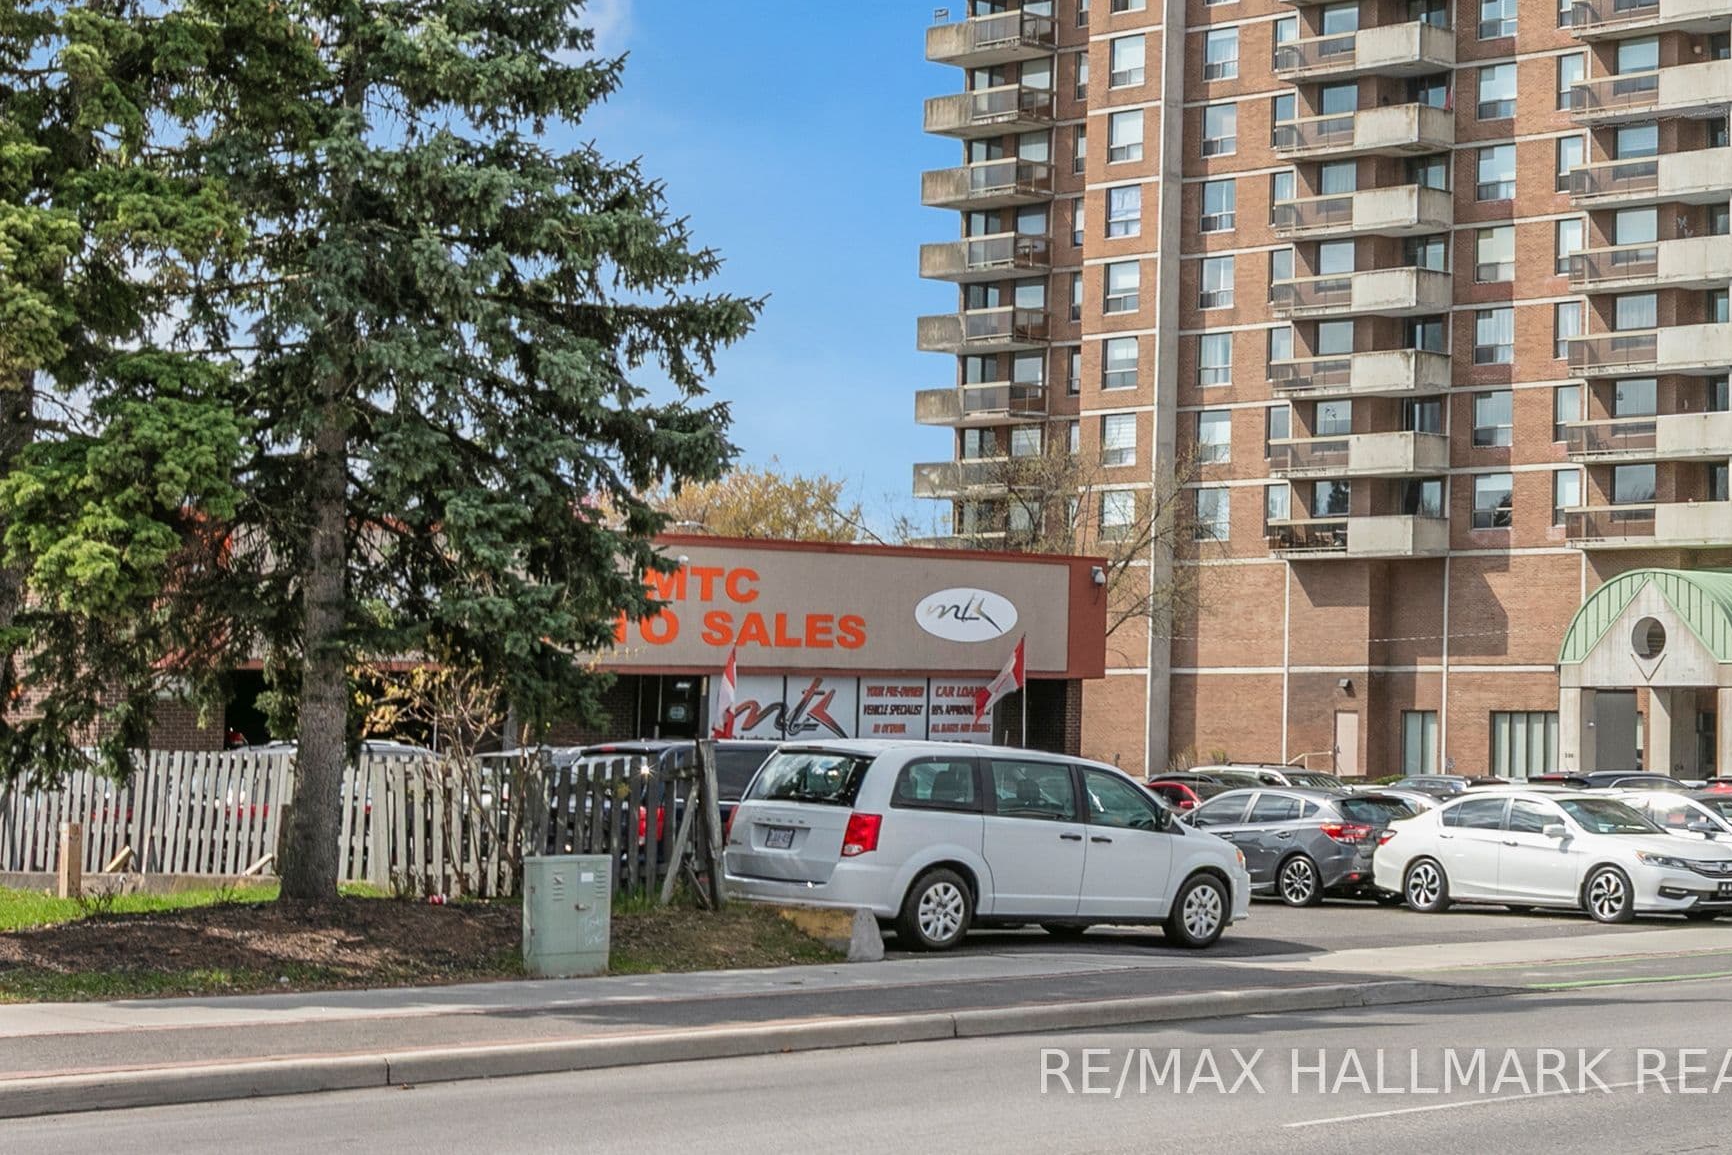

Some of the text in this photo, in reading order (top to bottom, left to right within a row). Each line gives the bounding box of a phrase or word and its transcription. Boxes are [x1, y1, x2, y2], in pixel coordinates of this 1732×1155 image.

[701, 609, 867, 649] SALES
[935, 685, 955, 698] CAR
[889, 704, 924, 716] SPECIALIST
